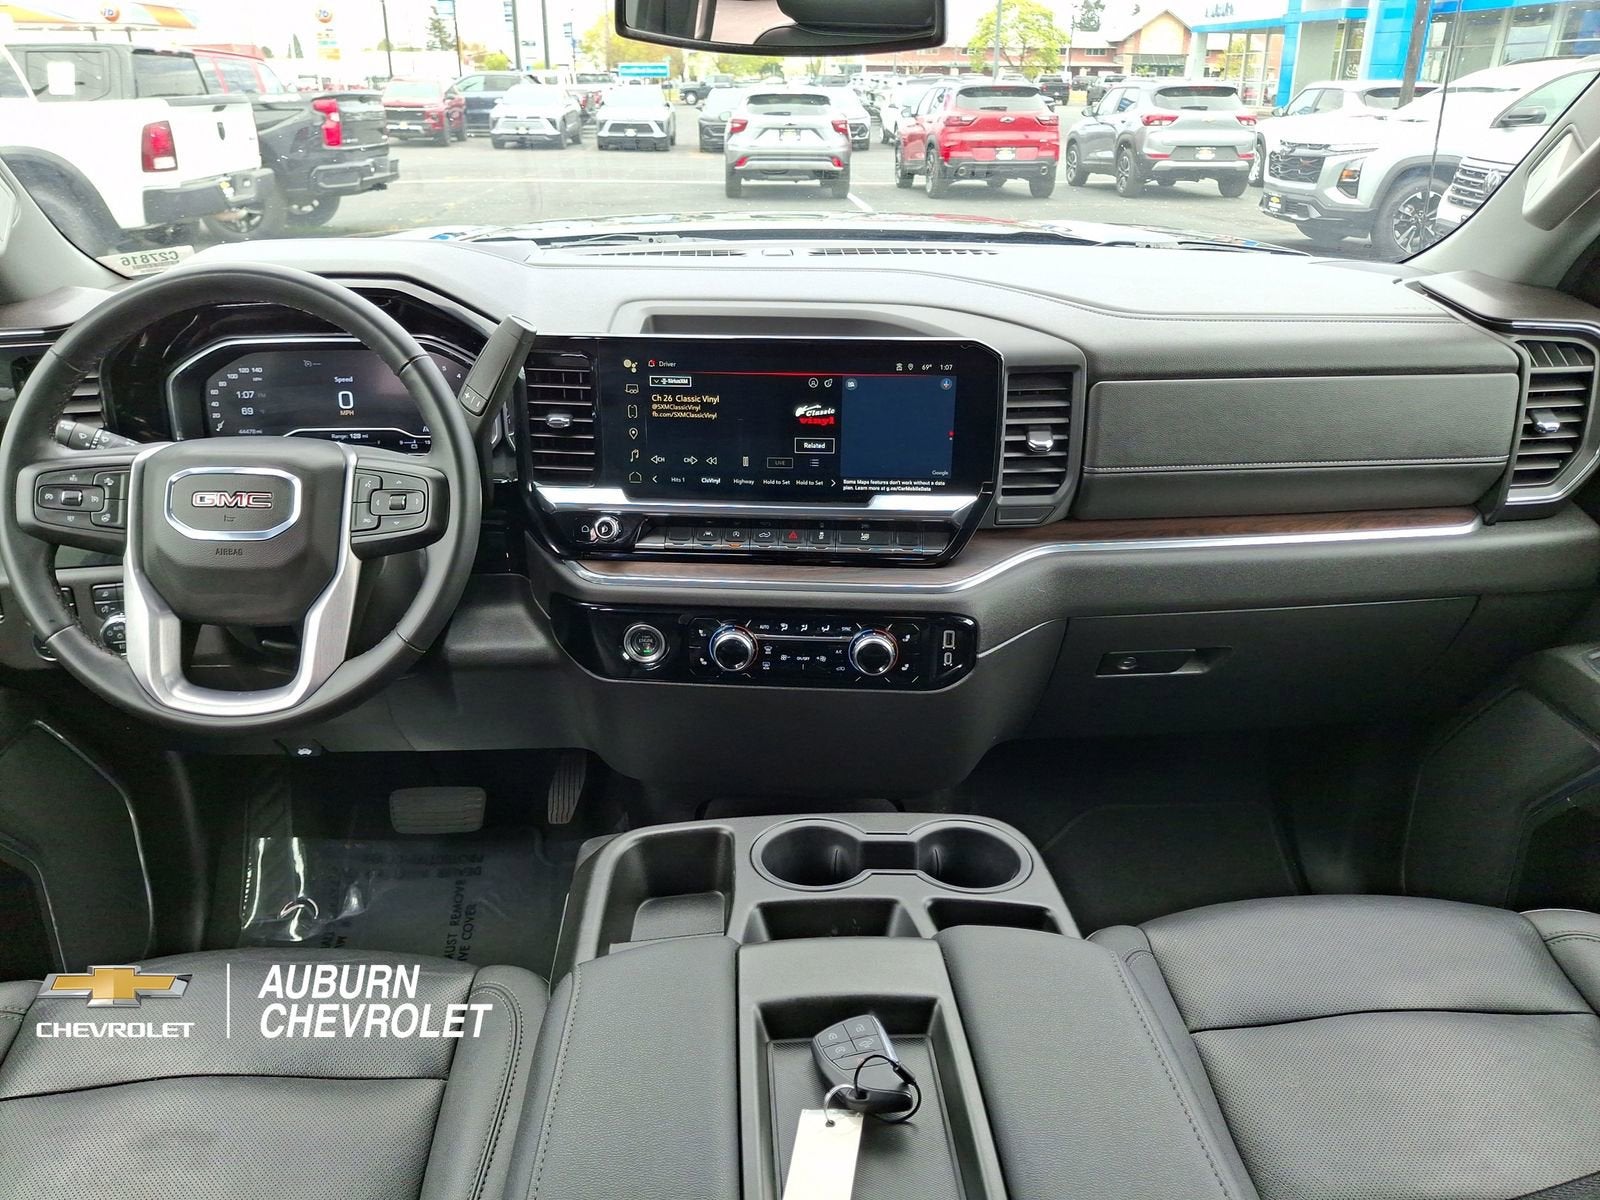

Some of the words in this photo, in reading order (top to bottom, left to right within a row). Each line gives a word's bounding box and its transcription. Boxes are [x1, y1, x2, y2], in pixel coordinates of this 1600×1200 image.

[236, 390, 255, 399] 1:07
[338, 390, 354, 409] 0
[702, 395, 720, 405] Vinyl
[652, 404, 701, 412] @SXMClassicVinyl
[806, 408, 835, 416] Classic
[652, 411, 717, 420] fb.com/SXMClassicVinyl
[192, 491, 272, 508] GMC
[461, 904, 477, 940] COVER
